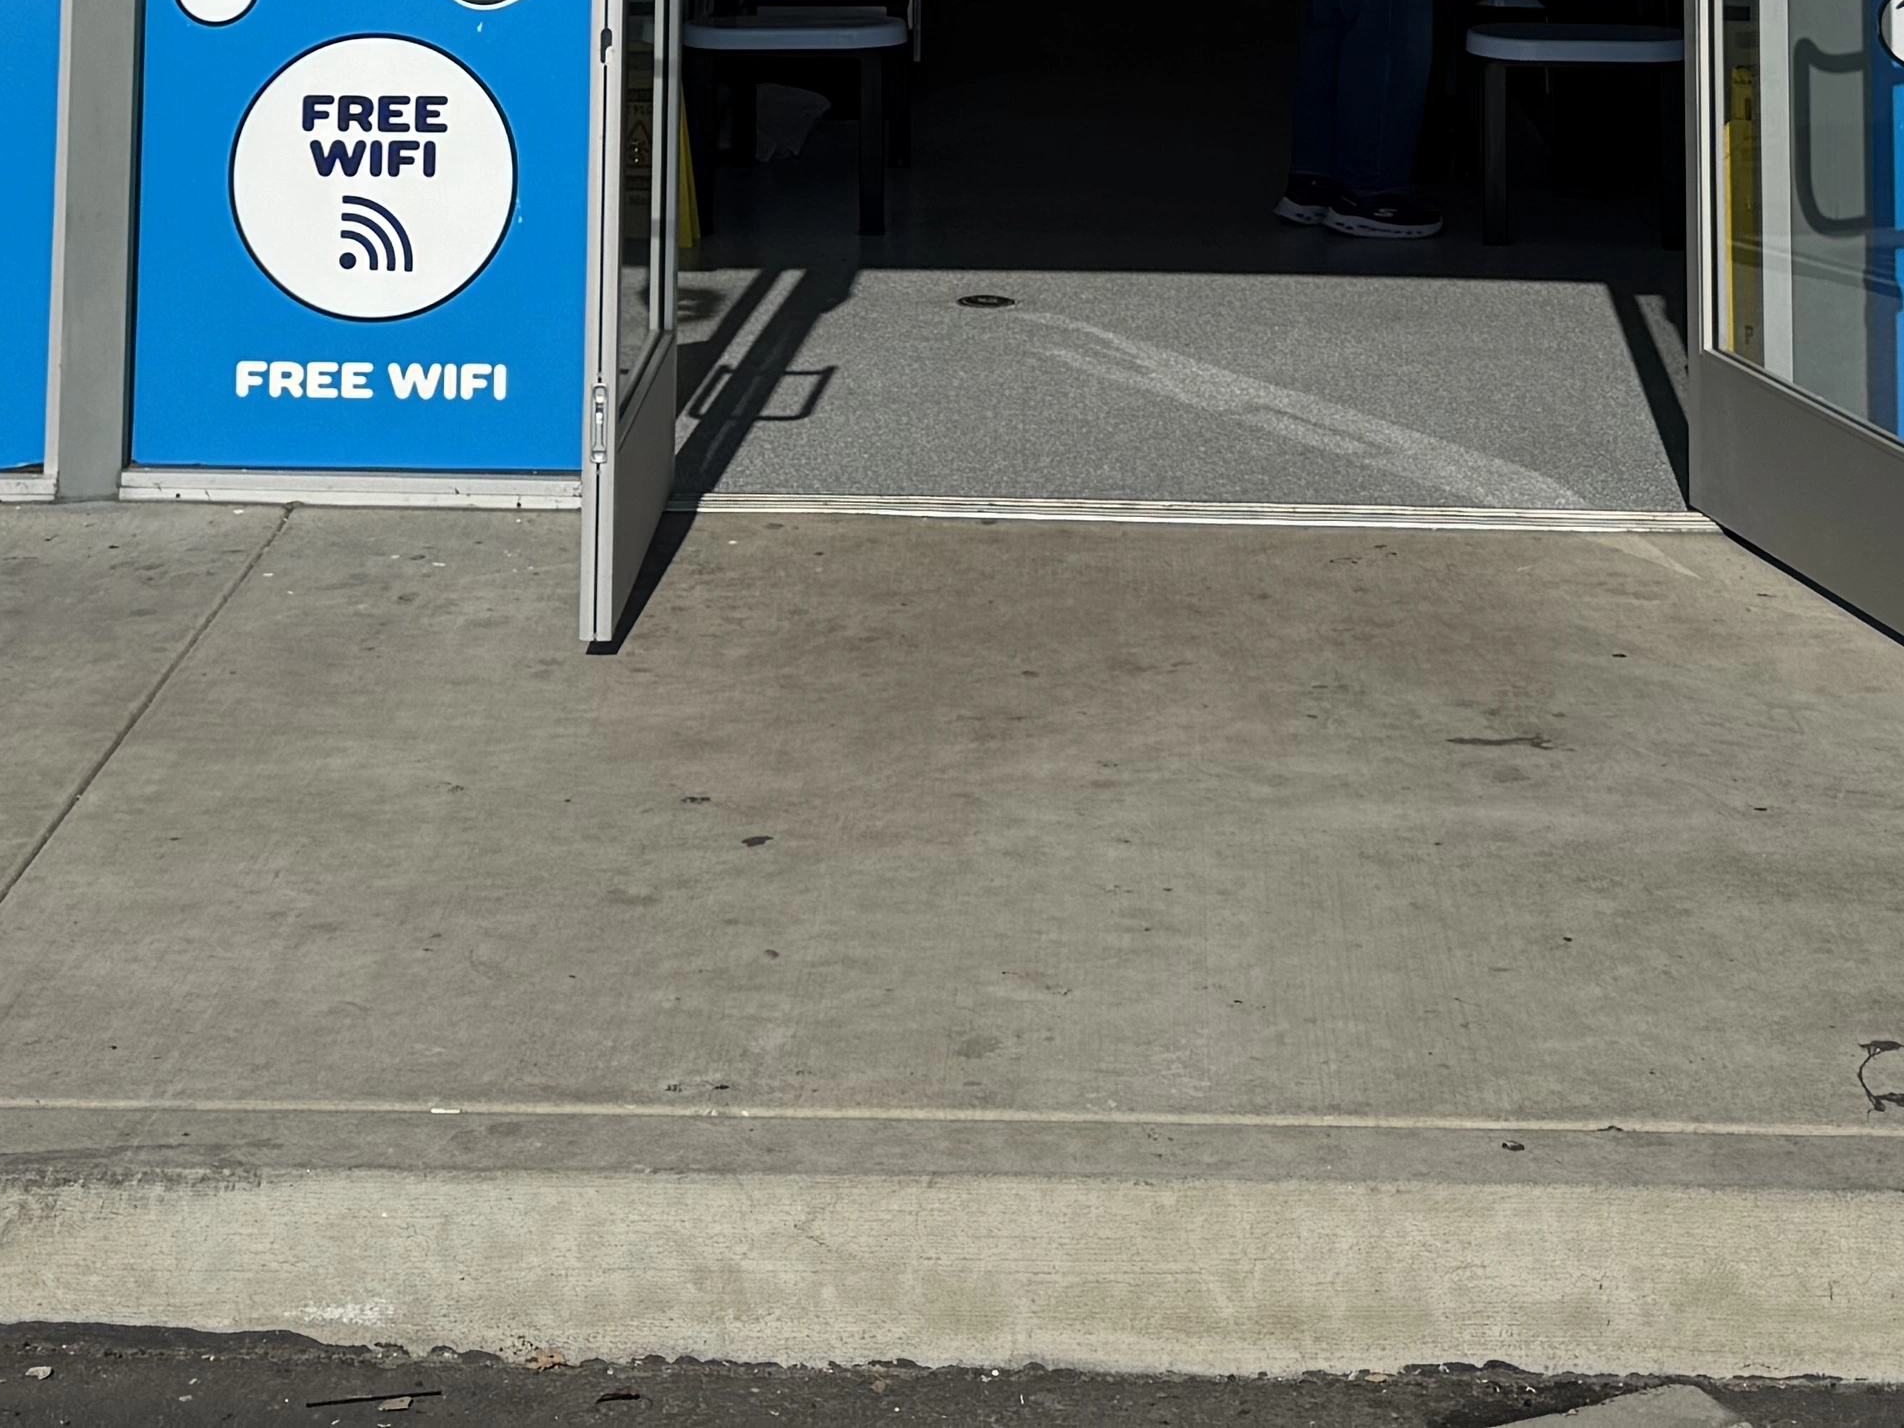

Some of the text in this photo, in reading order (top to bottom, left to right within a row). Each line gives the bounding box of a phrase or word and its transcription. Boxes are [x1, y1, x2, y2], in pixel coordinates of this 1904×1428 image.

[302, 95, 448, 134] FREE
[310, 140, 437, 178] WIFI
[236, 361, 507, 401] FREE WIFI
